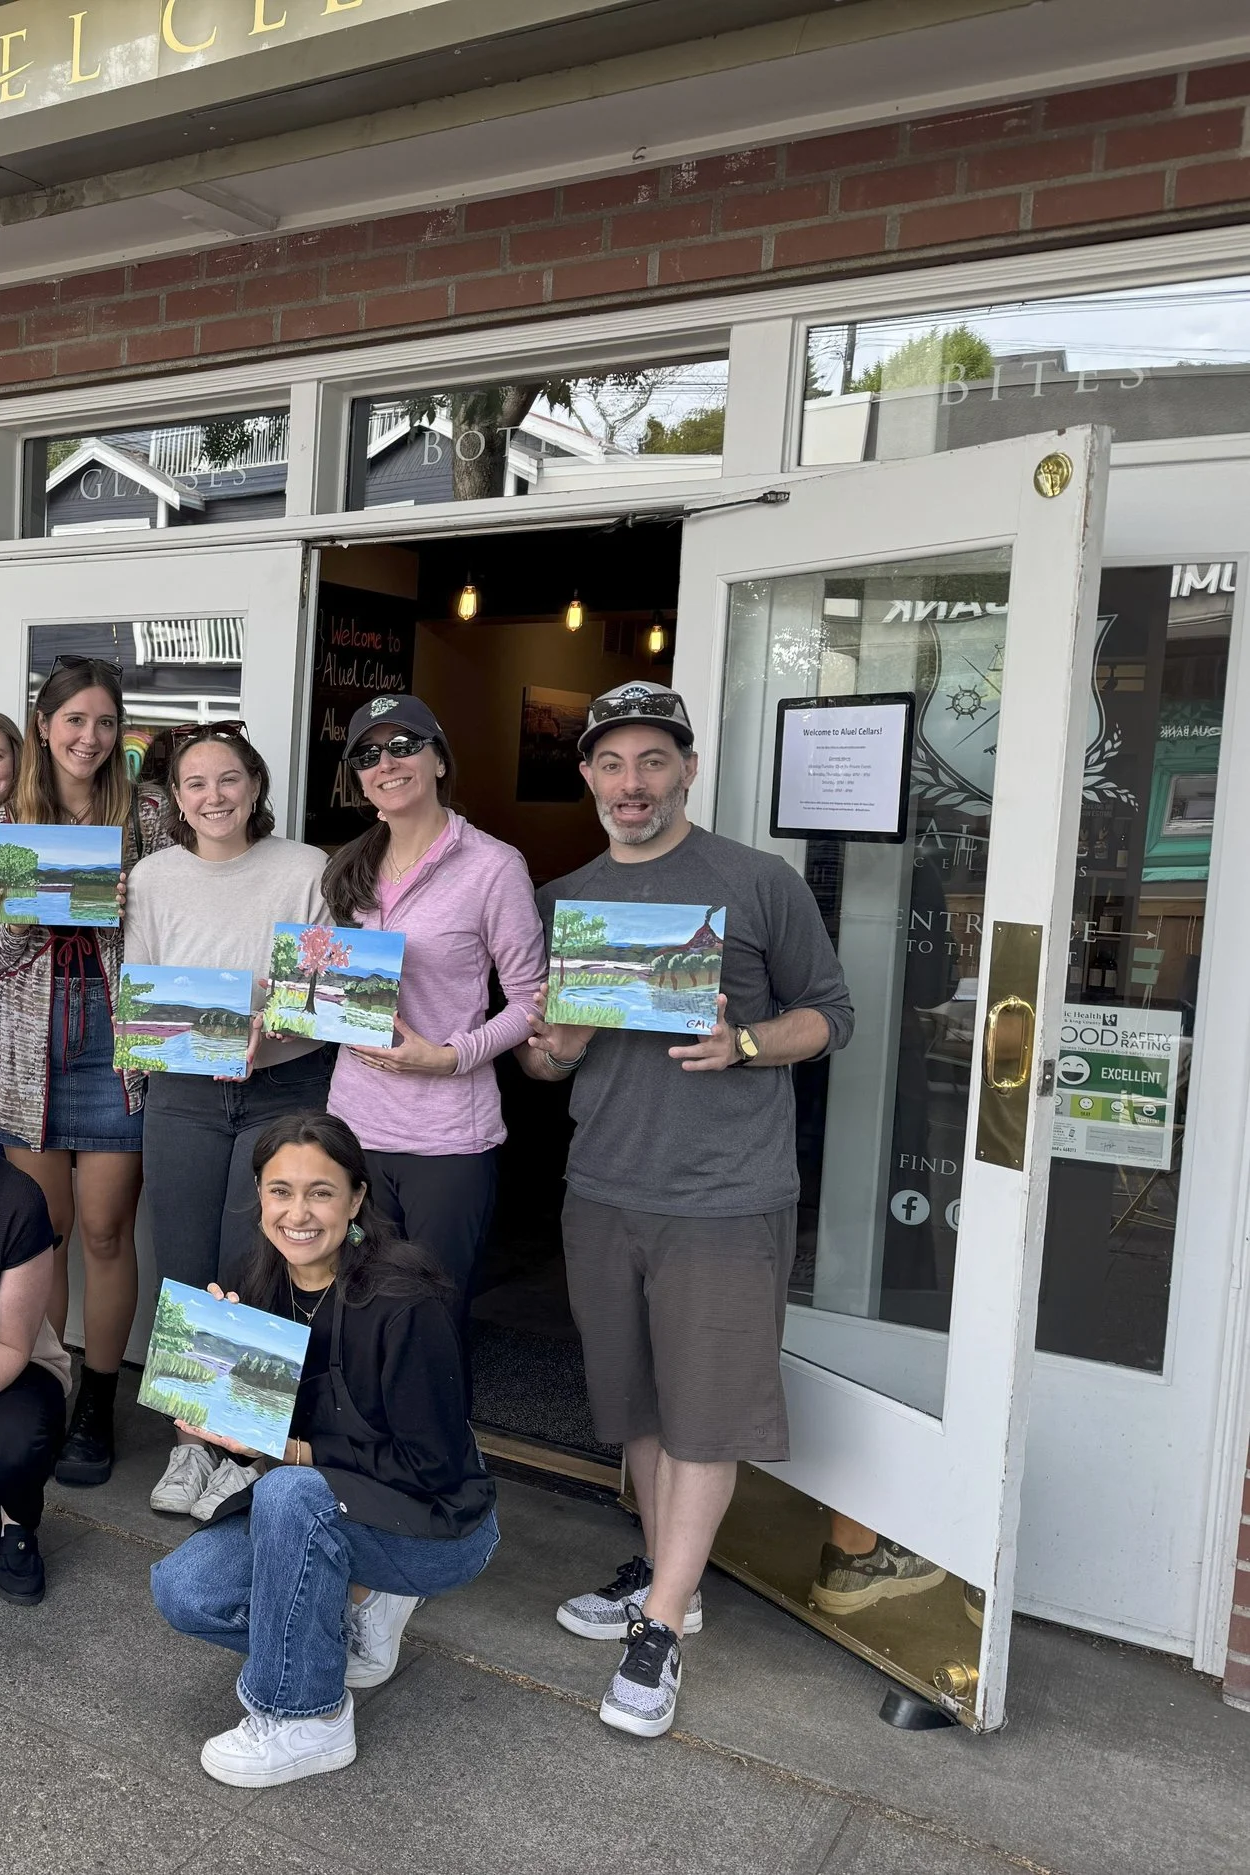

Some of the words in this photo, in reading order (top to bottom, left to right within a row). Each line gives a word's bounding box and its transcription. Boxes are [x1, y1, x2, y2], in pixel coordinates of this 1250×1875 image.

[939, 356, 1145, 406] BITES
[331, 616, 382, 651] Welcome
[388, 628, 401, 653] to
[322, 652, 360, 688] Aluel
[362, 660, 406, 691] Cellars
[803, 728, 831, 737] Welcome
[832, 728, 840, 736] to
[840, 727, 857, 736] Aluel
[858, 727, 883, 736] Cellars!
[905, 939, 933, 954] TO
[945, 942, 974, 957] TH
[1073, 1010, 1102, 1020] Health
[1060, 1025, 1119, 1047] OOD
[1121, 1030, 1172, 1043] SAFETY
[1120, 1040, 1171, 1052] RATING
[1101, 1067, 1162, 1084] EXCELLENT
[899, 1153, 957, 1176] FIND
